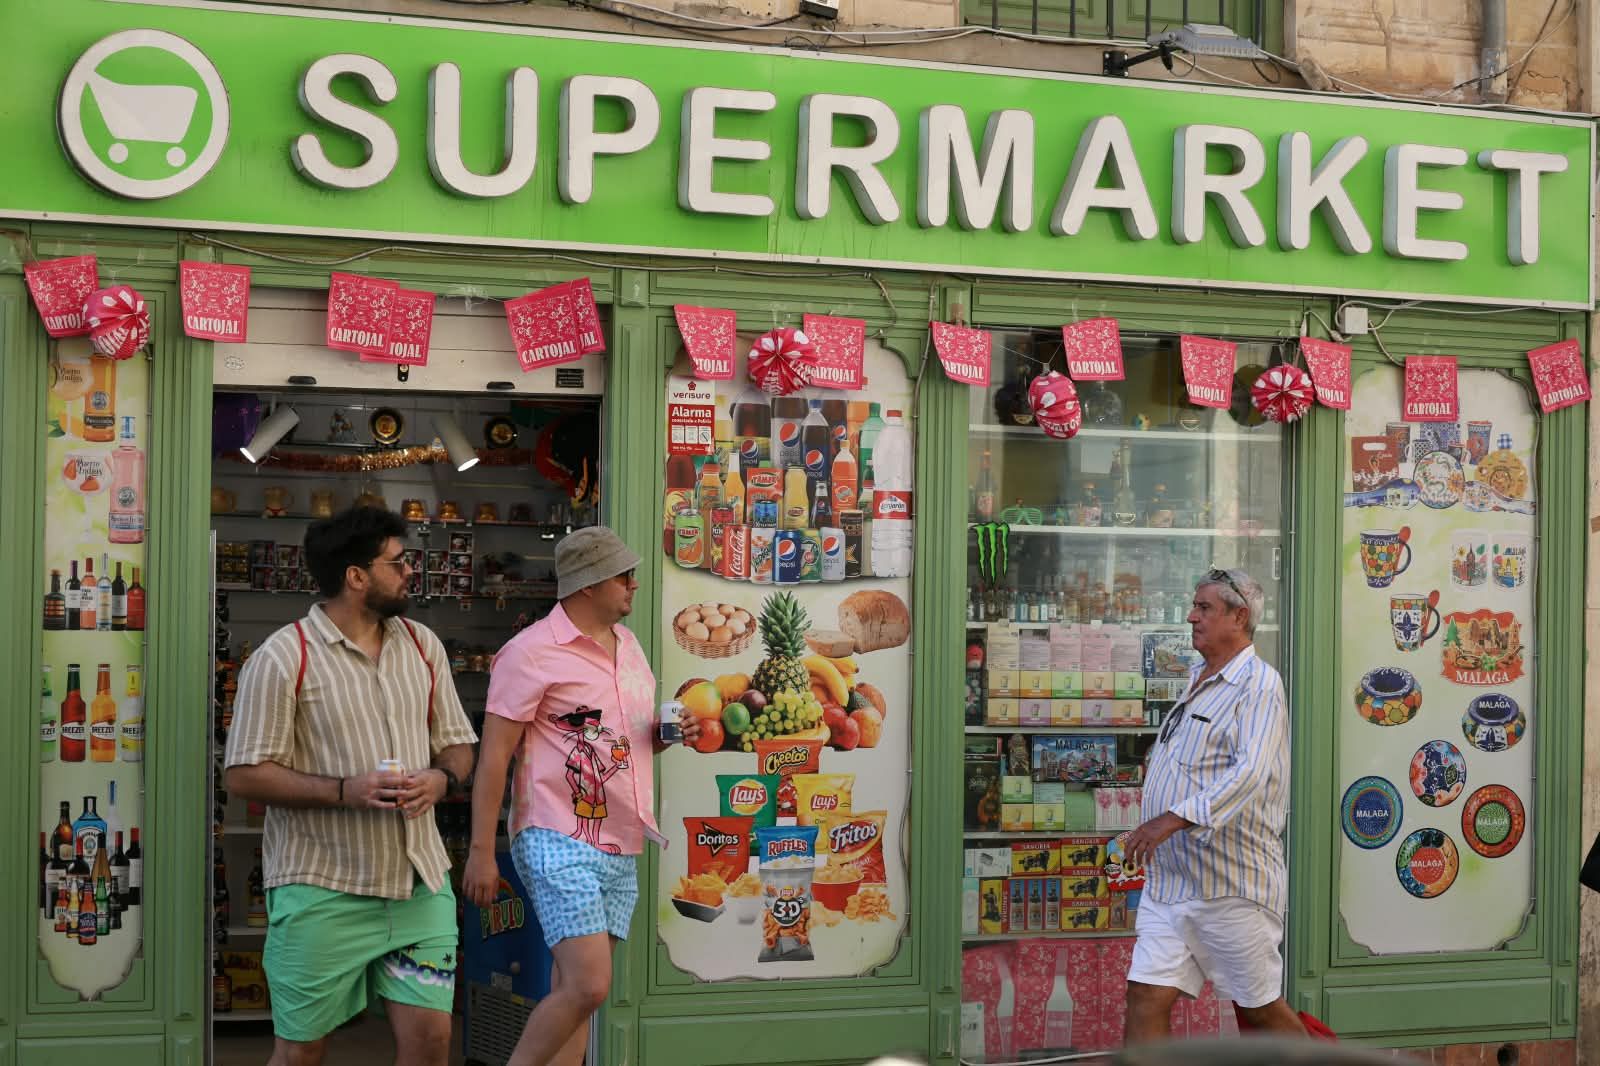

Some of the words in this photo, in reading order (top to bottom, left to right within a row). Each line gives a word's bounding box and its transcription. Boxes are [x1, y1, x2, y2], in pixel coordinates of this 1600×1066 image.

[290, 52, 1569, 266] SUPERMARKET
[45, 313, 81, 330] CARTOJ
[187, 315, 240, 335] CARTOJAL
[330, 327, 384, 348] CARTOJAL
[389, 341, 422, 358] TOJAL
[521, 340, 577, 364] CARTOJAL
[693, 357, 729, 374] TOJAL
[814, 364, 856, 384] ARTOJAL
[1070, 360, 1118, 375] CARTOJAL
[672, 391, 711, 400] verisure
[1542, 385, 1586, 407] CARTOJAL
[671, 405, 712, 418] Alarma
[1407, 402, 1451, 417] CARTOJAL
[776, 561, 796, 569] pepsi
[1455, 669, 1511, 684] MALAGA
[1479, 699, 1511, 710] MALAGA
[765, 747, 808, 775] Cheetos
[1356, 808, 1390, 818] MALAGA
[1477, 816, 1509, 826] MALAGA
[697, 832, 740, 847] Doritos
[829, 822, 878, 853] Fritos
[767, 838, 808, 856] RUFFLES
[1410, 859, 1444, 868] MALAGA
